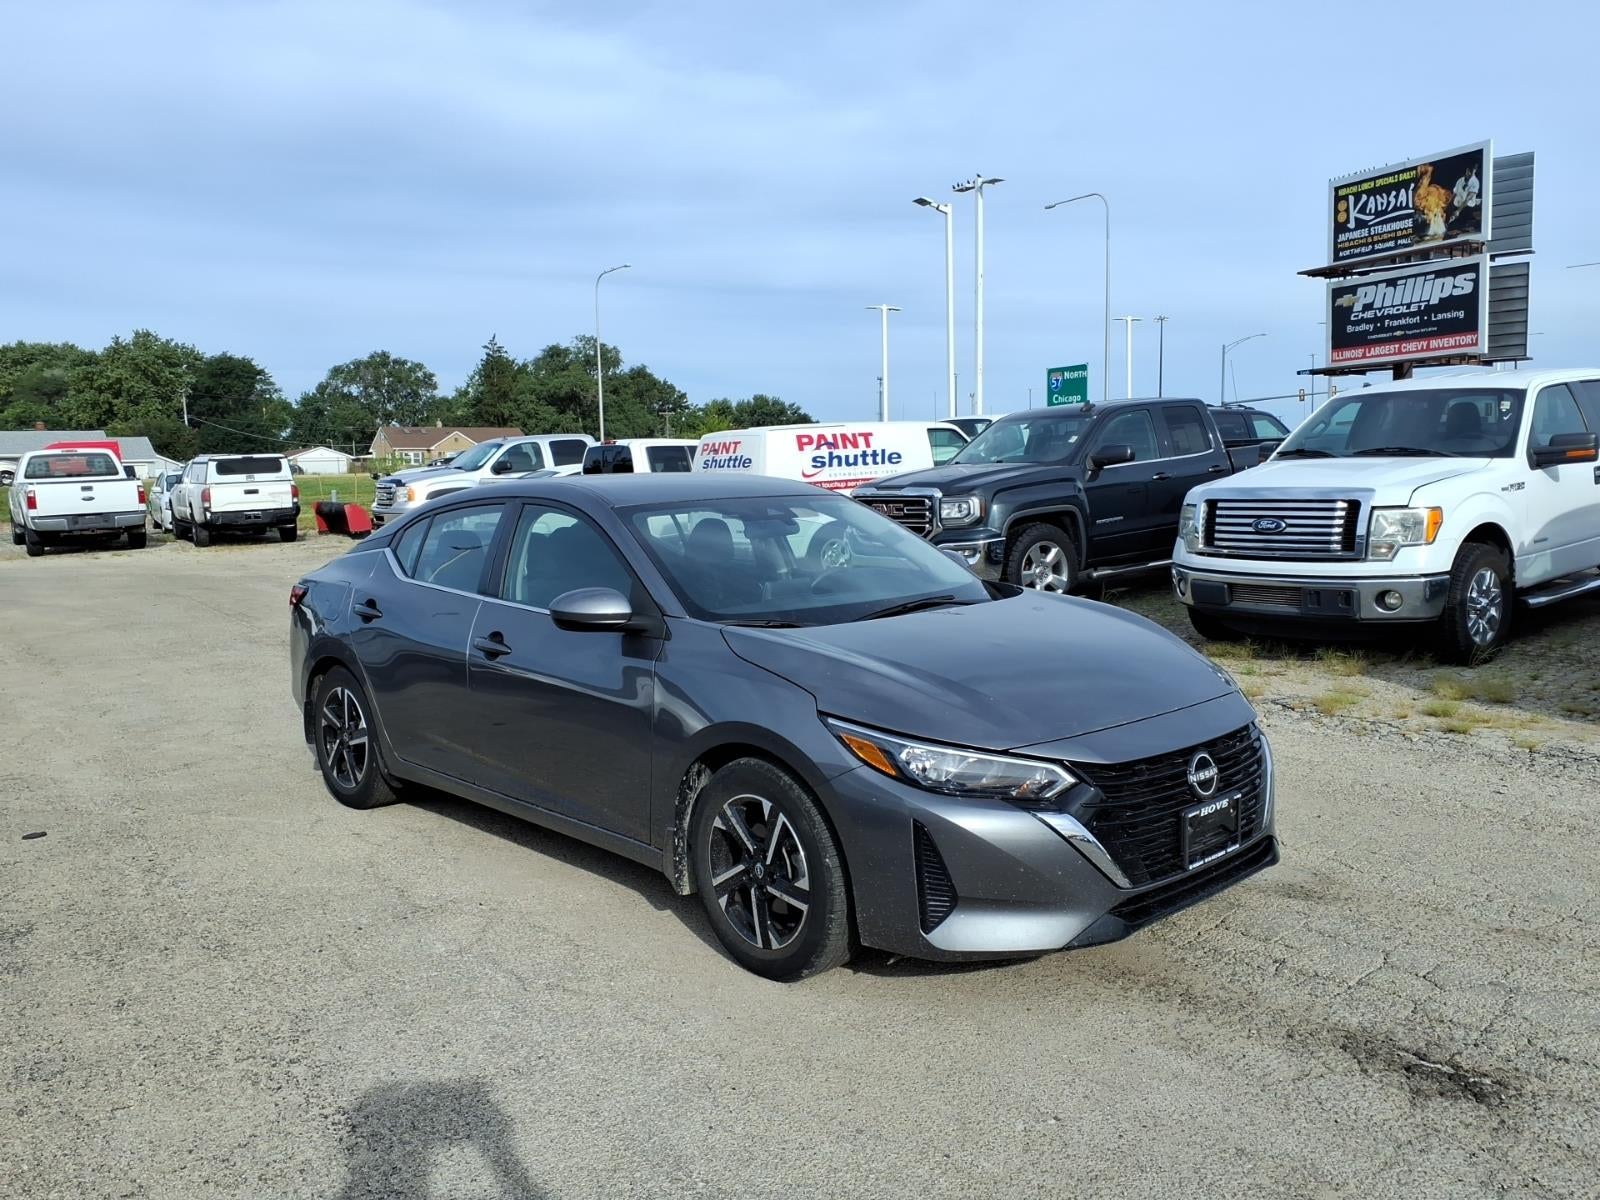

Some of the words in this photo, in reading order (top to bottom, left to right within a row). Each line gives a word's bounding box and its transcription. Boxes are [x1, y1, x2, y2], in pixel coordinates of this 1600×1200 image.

[1338, 228, 1369, 242] JAPANESE
[1370, 218, 1413, 235] STEAKHOUSE
[1338, 237, 1366, 248] HIBACHI
[1373, 233, 1396, 242] SUSHI
[1397, 228, 1413, 238] BAR
[1339, 245, 1373, 257] NORTHFIELD
[1374, 240, 1396, 250] SQUARE
[1353, 272, 1476, 312] Phillips
[1346, 322, 1374, 333] Bradley
[1385, 315, 1420, 328] Frankfort
[1431, 309, 1464, 321] Lansing
[1350, 301, 1428, 321] CHEVROLET
[1366, 344, 1400, 357] LARGEST
[1401, 340, 1429, 352] CHEVY
[1430, 334, 1478, 349] INVENTORY
[1051, 376, 1062, 388] 57
[1052, 394, 1082, 404] Chicago
[700, 441, 741, 456] PAINT
[795, 432, 873, 452] PAINT
[702, 454, 752, 469] shuttle
[811, 449, 902, 469] shuttle
[1258, 520, 1277, 529] Ford
[1189, 765, 1218, 783] NISSAN
